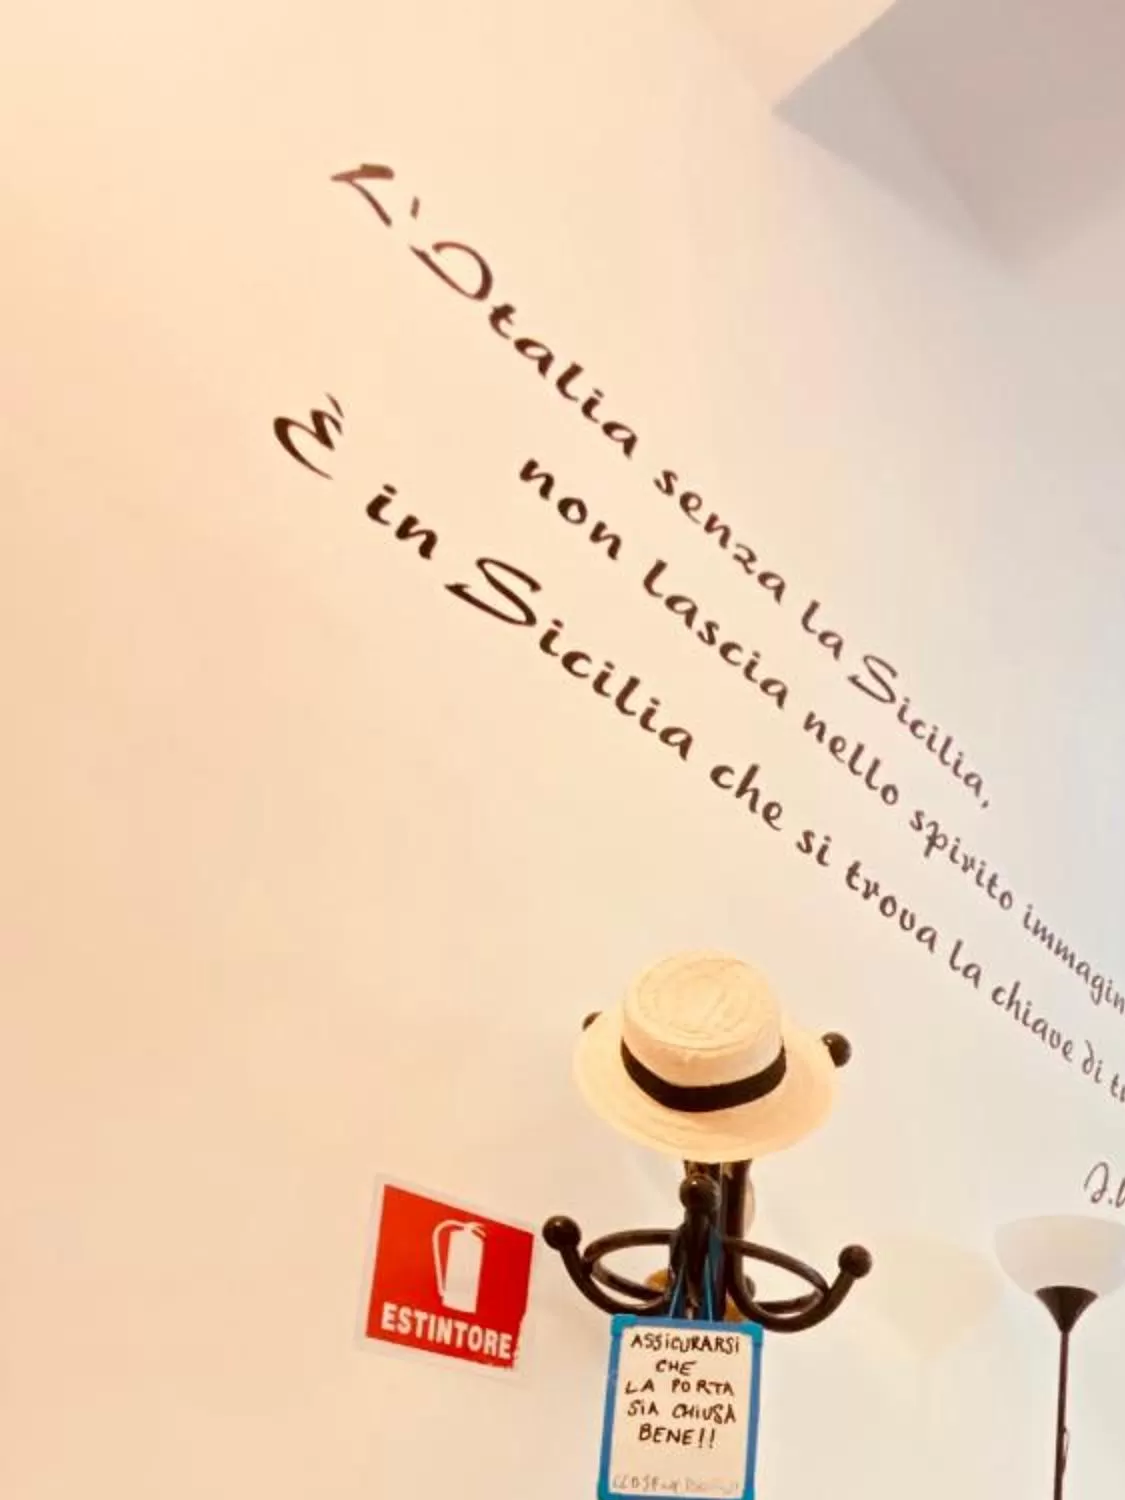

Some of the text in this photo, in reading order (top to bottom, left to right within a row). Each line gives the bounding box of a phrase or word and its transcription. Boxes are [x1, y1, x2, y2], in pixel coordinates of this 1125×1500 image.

[653, 470, 785, 605] senza
[801, 600, 843, 660] la
[848, 655, 989, 809] Sicilia,
[519, 459, 622, 560] non
[643, 560, 788, 709] lascia
[803, 711, 898, 805] nello
[910, 810, 1012, 909] spirito
[366, 484, 438, 560] in
[444, 557, 693, 761] Sicilia
[710, 764, 782, 831] che
[796, 830, 831, 866] si
[846, 861, 937, 953] trova
[949, 939, 981, 988] la
[992, 981, 1072, 1061] chiave
[1082, 1040, 1102, 1083] di
[381, 1301, 512, 1360] ESTINTORE
[624, 1379, 734, 1396] LA PORTA
[655, 1359, 697, 1376] CHE
[638, 1423, 716, 1448] BENE!!
